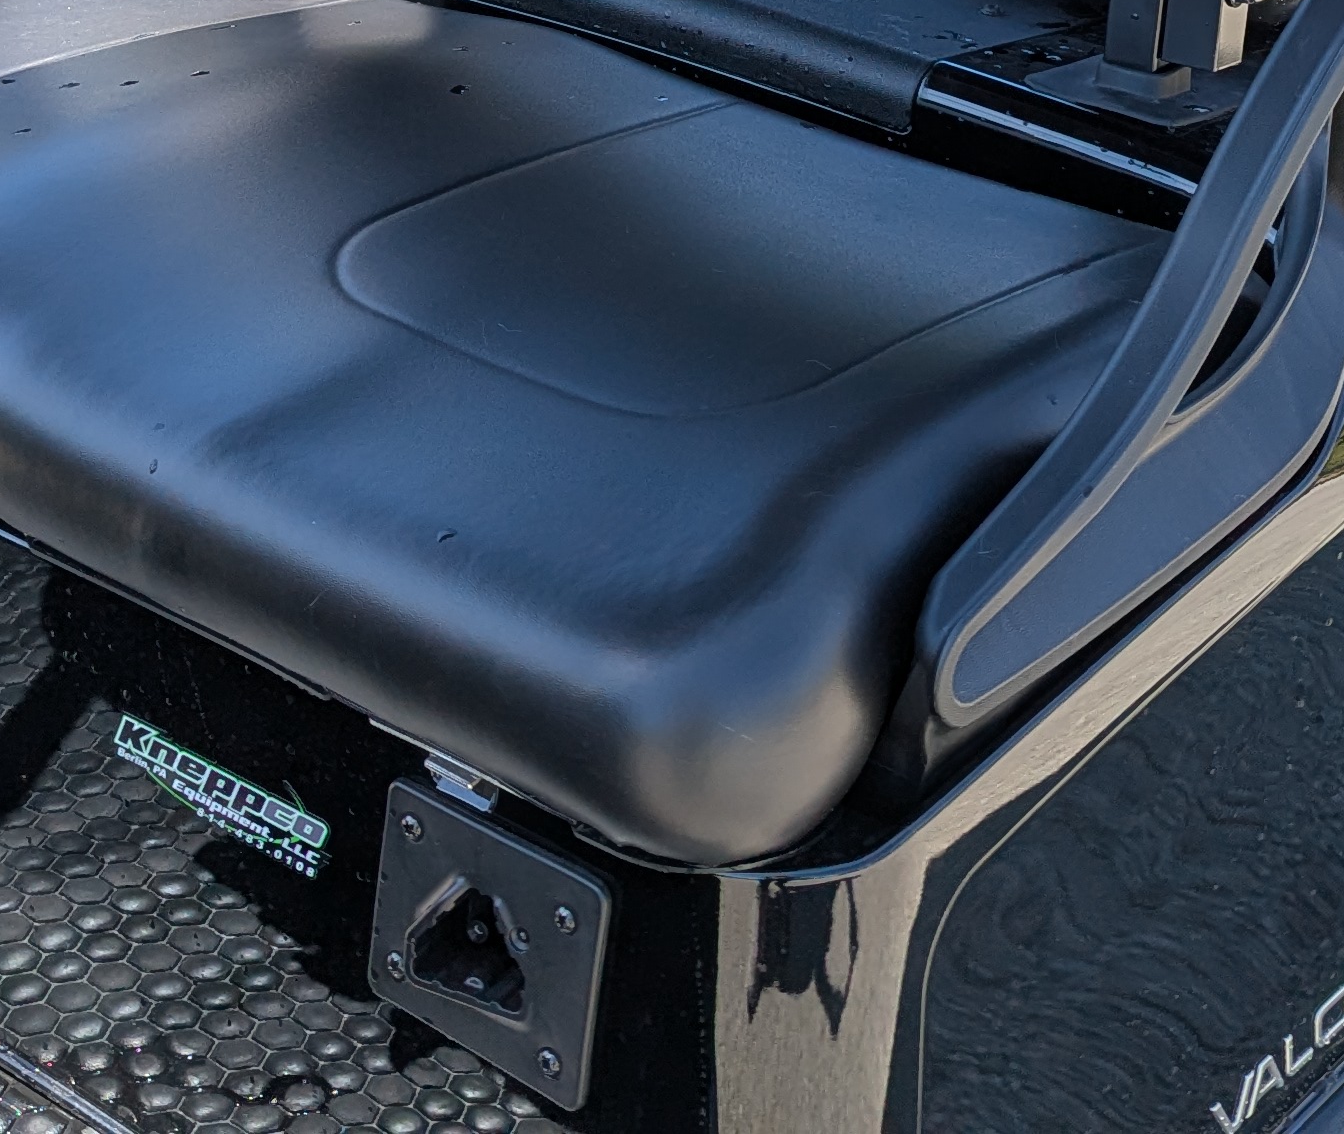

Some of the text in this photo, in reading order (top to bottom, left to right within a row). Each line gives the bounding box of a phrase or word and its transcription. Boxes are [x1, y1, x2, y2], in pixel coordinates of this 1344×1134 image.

[117, 746, 167, 779] Berlin, PA
[172, 779, 321, 864] Equipment, LLC
